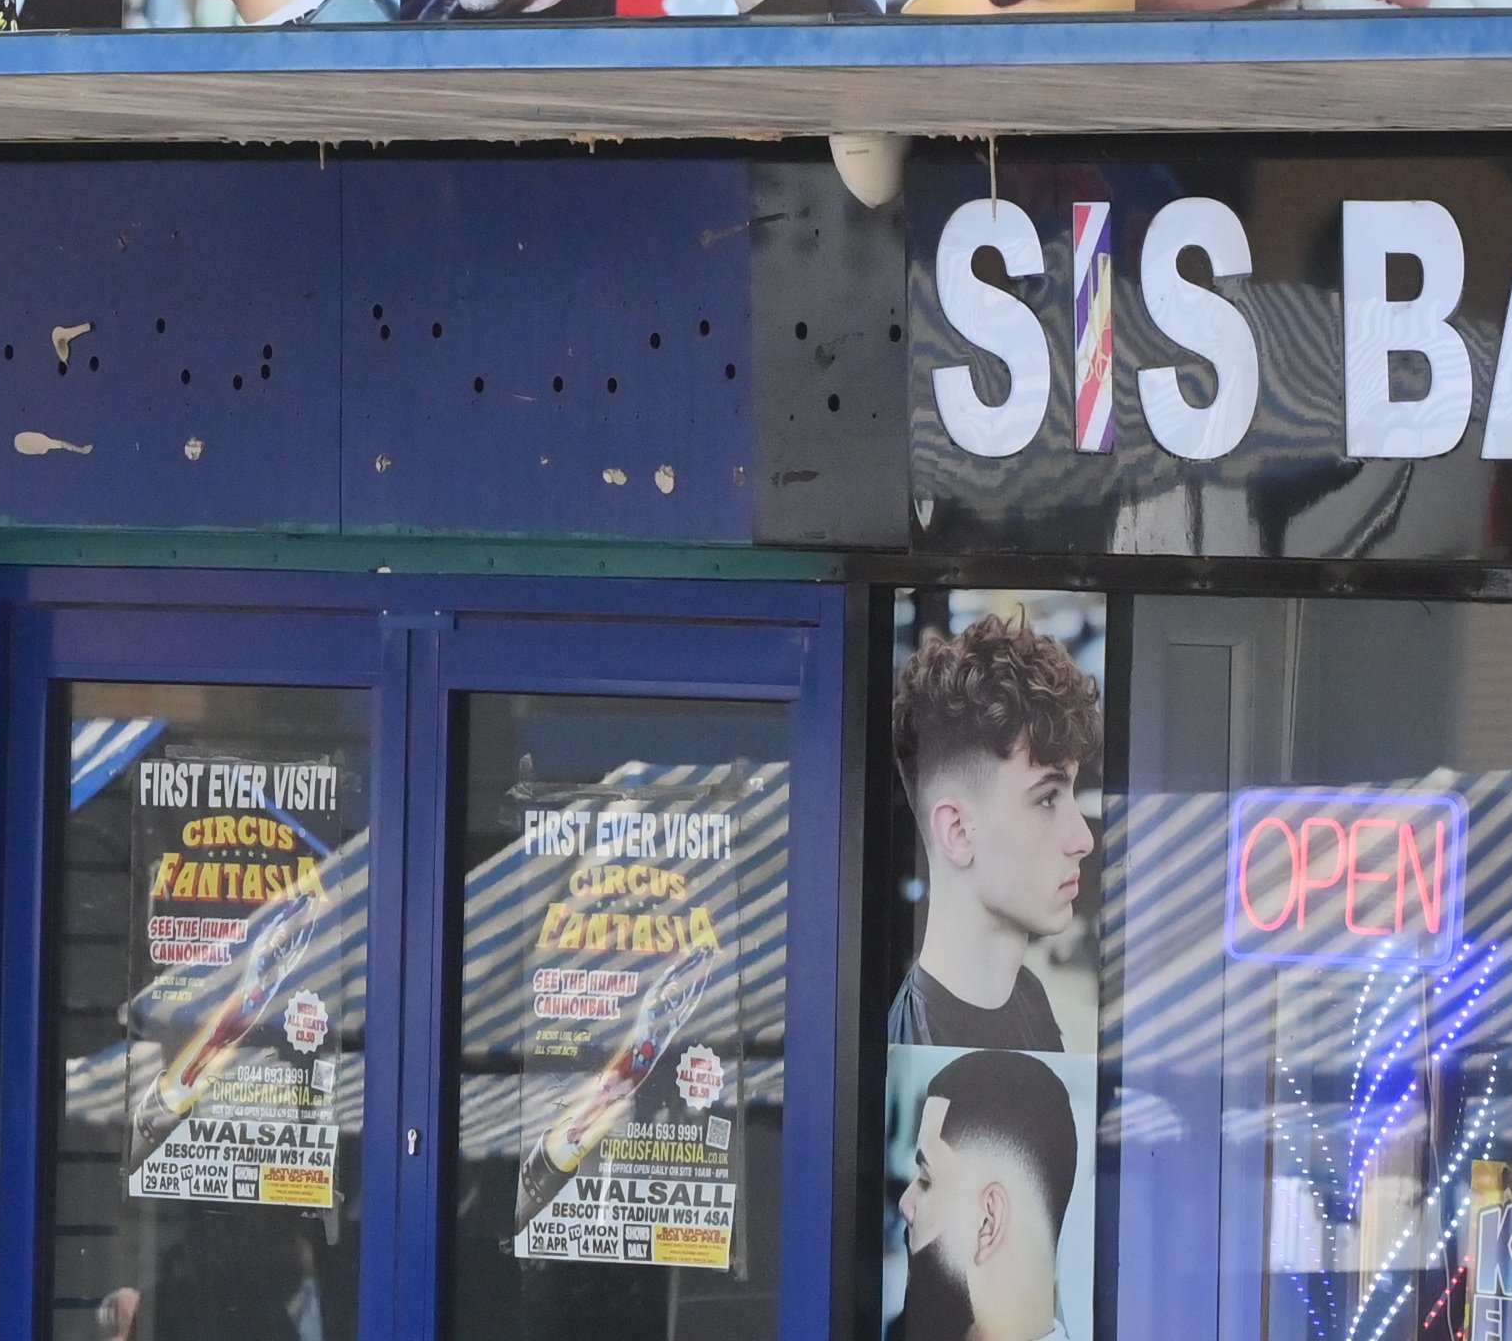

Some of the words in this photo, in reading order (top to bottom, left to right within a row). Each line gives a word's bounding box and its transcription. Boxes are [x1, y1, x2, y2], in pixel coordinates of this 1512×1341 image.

[140, 762, 204, 807] FIRST
[208, 765, 267, 809] EVER
[274, 766, 337, 811] VISIT!
[183, 815, 295, 850] CIRCUS
[525, 810, 590, 856] FIRST
[596, 812, 656, 858] EVER
[664, 813, 730, 860] VISIT!
[150, 852, 329, 903] FANTASIA
[569, 864, 688, 901] CIRCUS
[1236, 814, 1446, 936] OPEN
[149, 916, 174, 938] SEE
[176, 918, 200, 940] THE
[200, 919, 248, 942] HUMAN
[535, 902, 724, 955] FANTASIA
[151, 941, 232, 965] CANNONBALL
[534, 968, 560, 992] SEE
[561, 969, 587, 994] THE
[588, 971, 638, 996] HUMAN
[534, 994, 620, 1019] CANNONBALL
[238, 1066, 262, 1083] 0844
[264, 1067, 283, 1083] 693
[285, 1068, 309, 1084] 9991
[189, 1120, 334, 1149] WALSALL
[628, 1122, 653, 1139] 0844
[656, 1124, 675, 1140] 693
[678, 1124, 703, 1141] 9991
[165, 1143, 220, 1160] BESCOTT
[223, 1146, 277, 1164] STADIUM
[280, 1150, 304, 1165] WS1
[308, 1152, 331, 1166] 4SA
[148, 1162, 178, 1174] WED
[194, 1165, 228, 1177] MON
[146, 1176, 158, 1189] 29
[160, 1177, 179, 1191] APR
[193, 1179, 200, 1191] 4
[203, 1179, 228, 1194] MAY
[576, 1178, 732, 1209] WALSALL
[613, 1205, 669, 1223] STADIUM
[673, 1210, 699, 1224] WS1
[704, 1211, 729, 1226] 4SA
[533, 1222, 566, 1234] WED
[584, 1225, 618, 1237] MON
[547, 1236, 568, 1251] APR
[582, 1239, 589, 1253] 4
[593, 1240, 619, 1255] MAY
